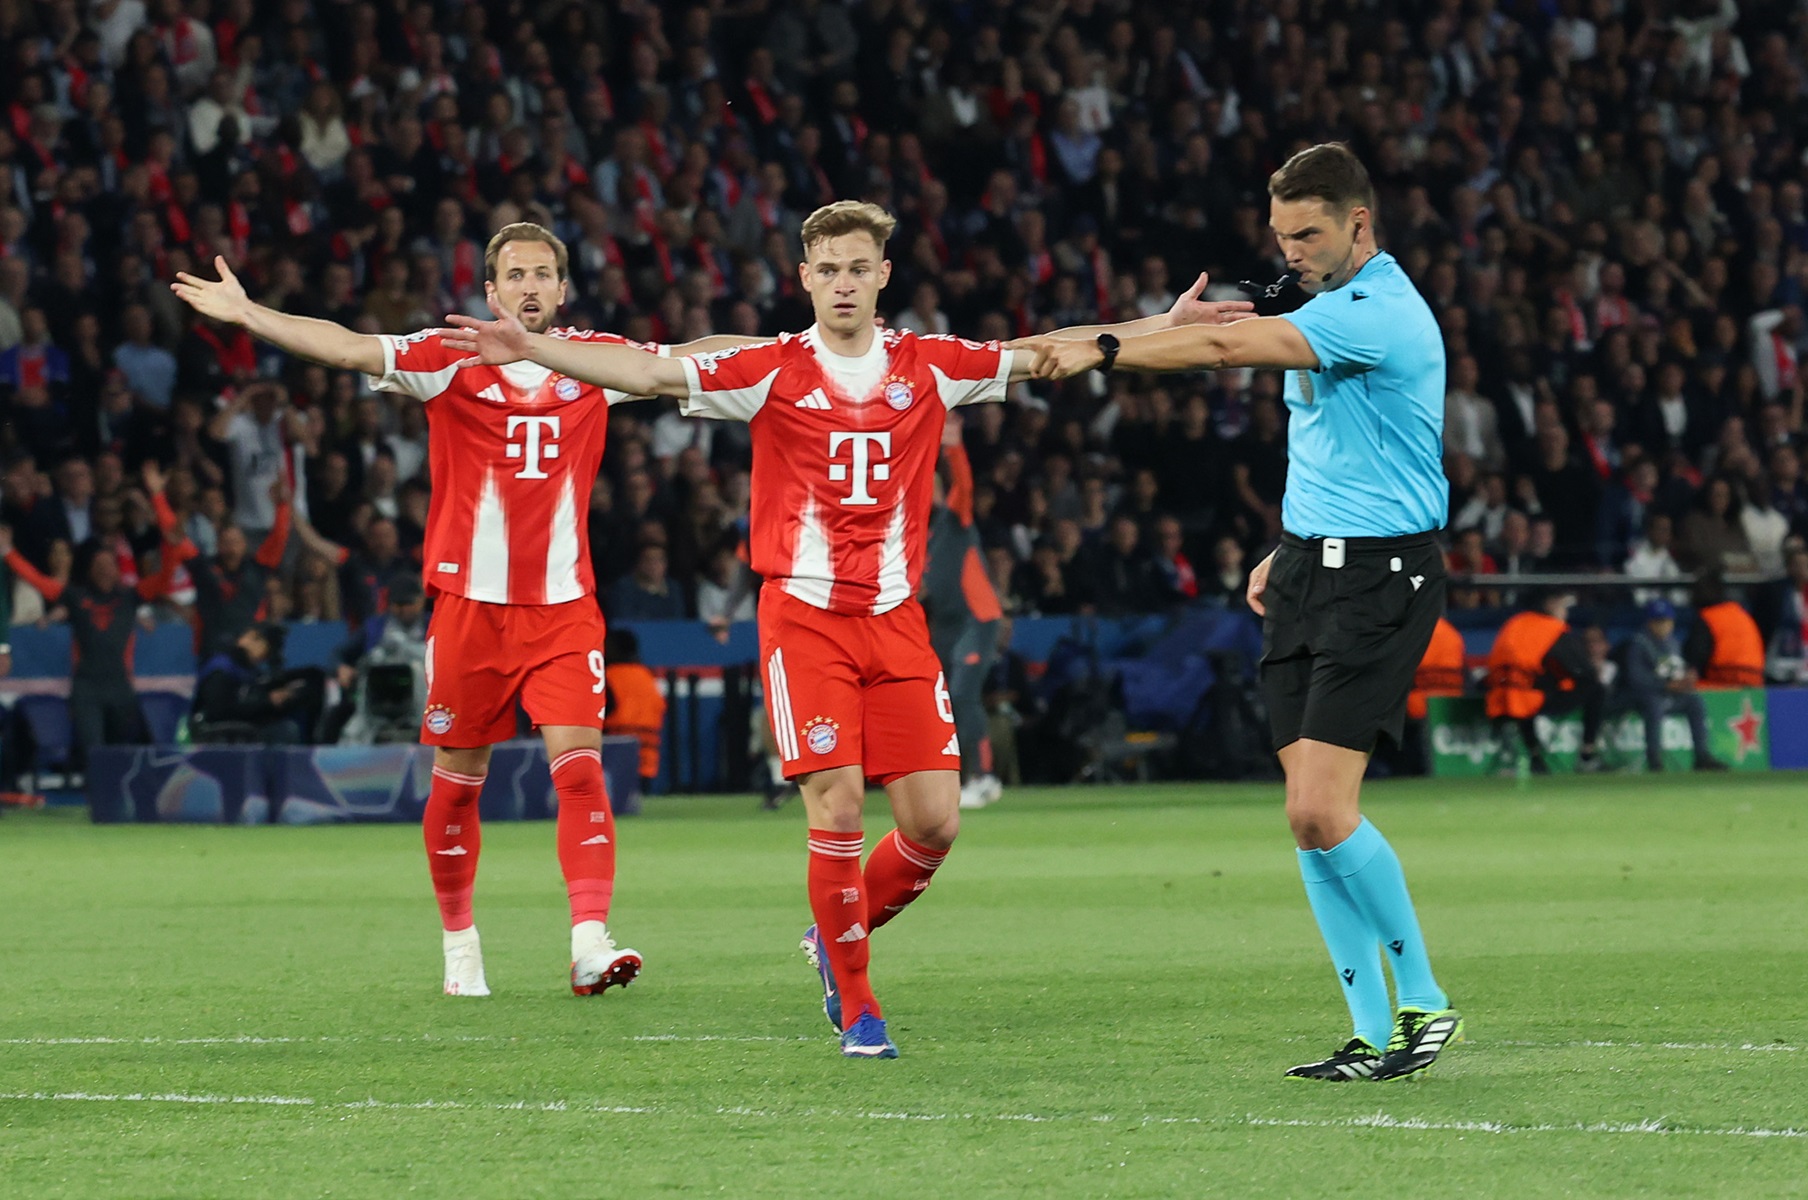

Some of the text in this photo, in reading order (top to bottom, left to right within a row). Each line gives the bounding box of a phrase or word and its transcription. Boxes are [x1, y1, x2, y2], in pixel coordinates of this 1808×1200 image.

[506, 415, 560, 479] T
[828, 431, 891, 505] T
[587, 649, 606, 694] 9
[934, 671, 955, 724] 6
